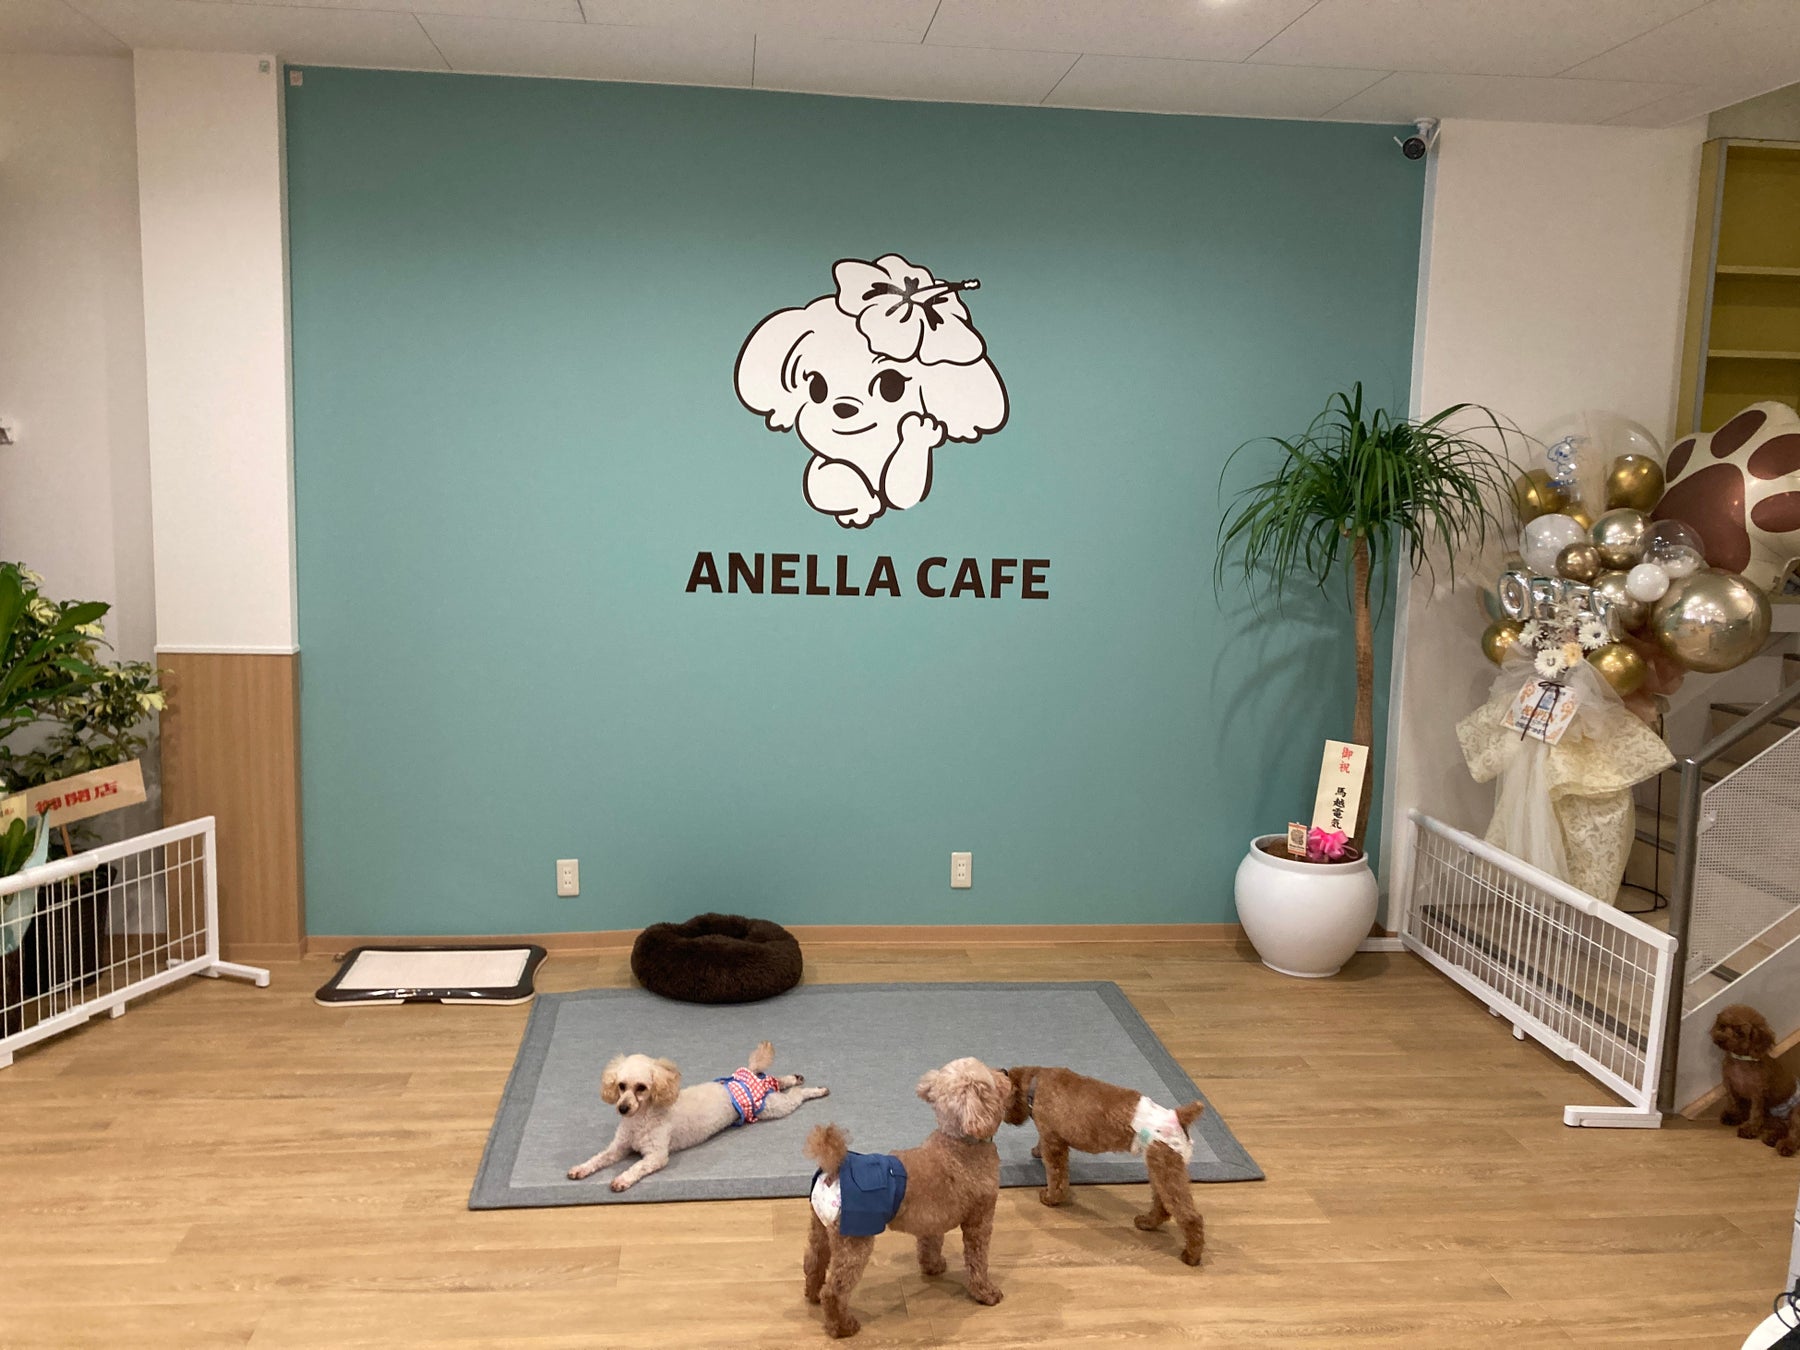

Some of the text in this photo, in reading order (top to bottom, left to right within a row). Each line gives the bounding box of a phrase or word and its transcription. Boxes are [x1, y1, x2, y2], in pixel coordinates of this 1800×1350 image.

[685, 551, 1051, 600] ANELLA CAFE
[1339, 747, 1353, 774] 御祝
[1331, 787, 1347, 829] 馬越電気
